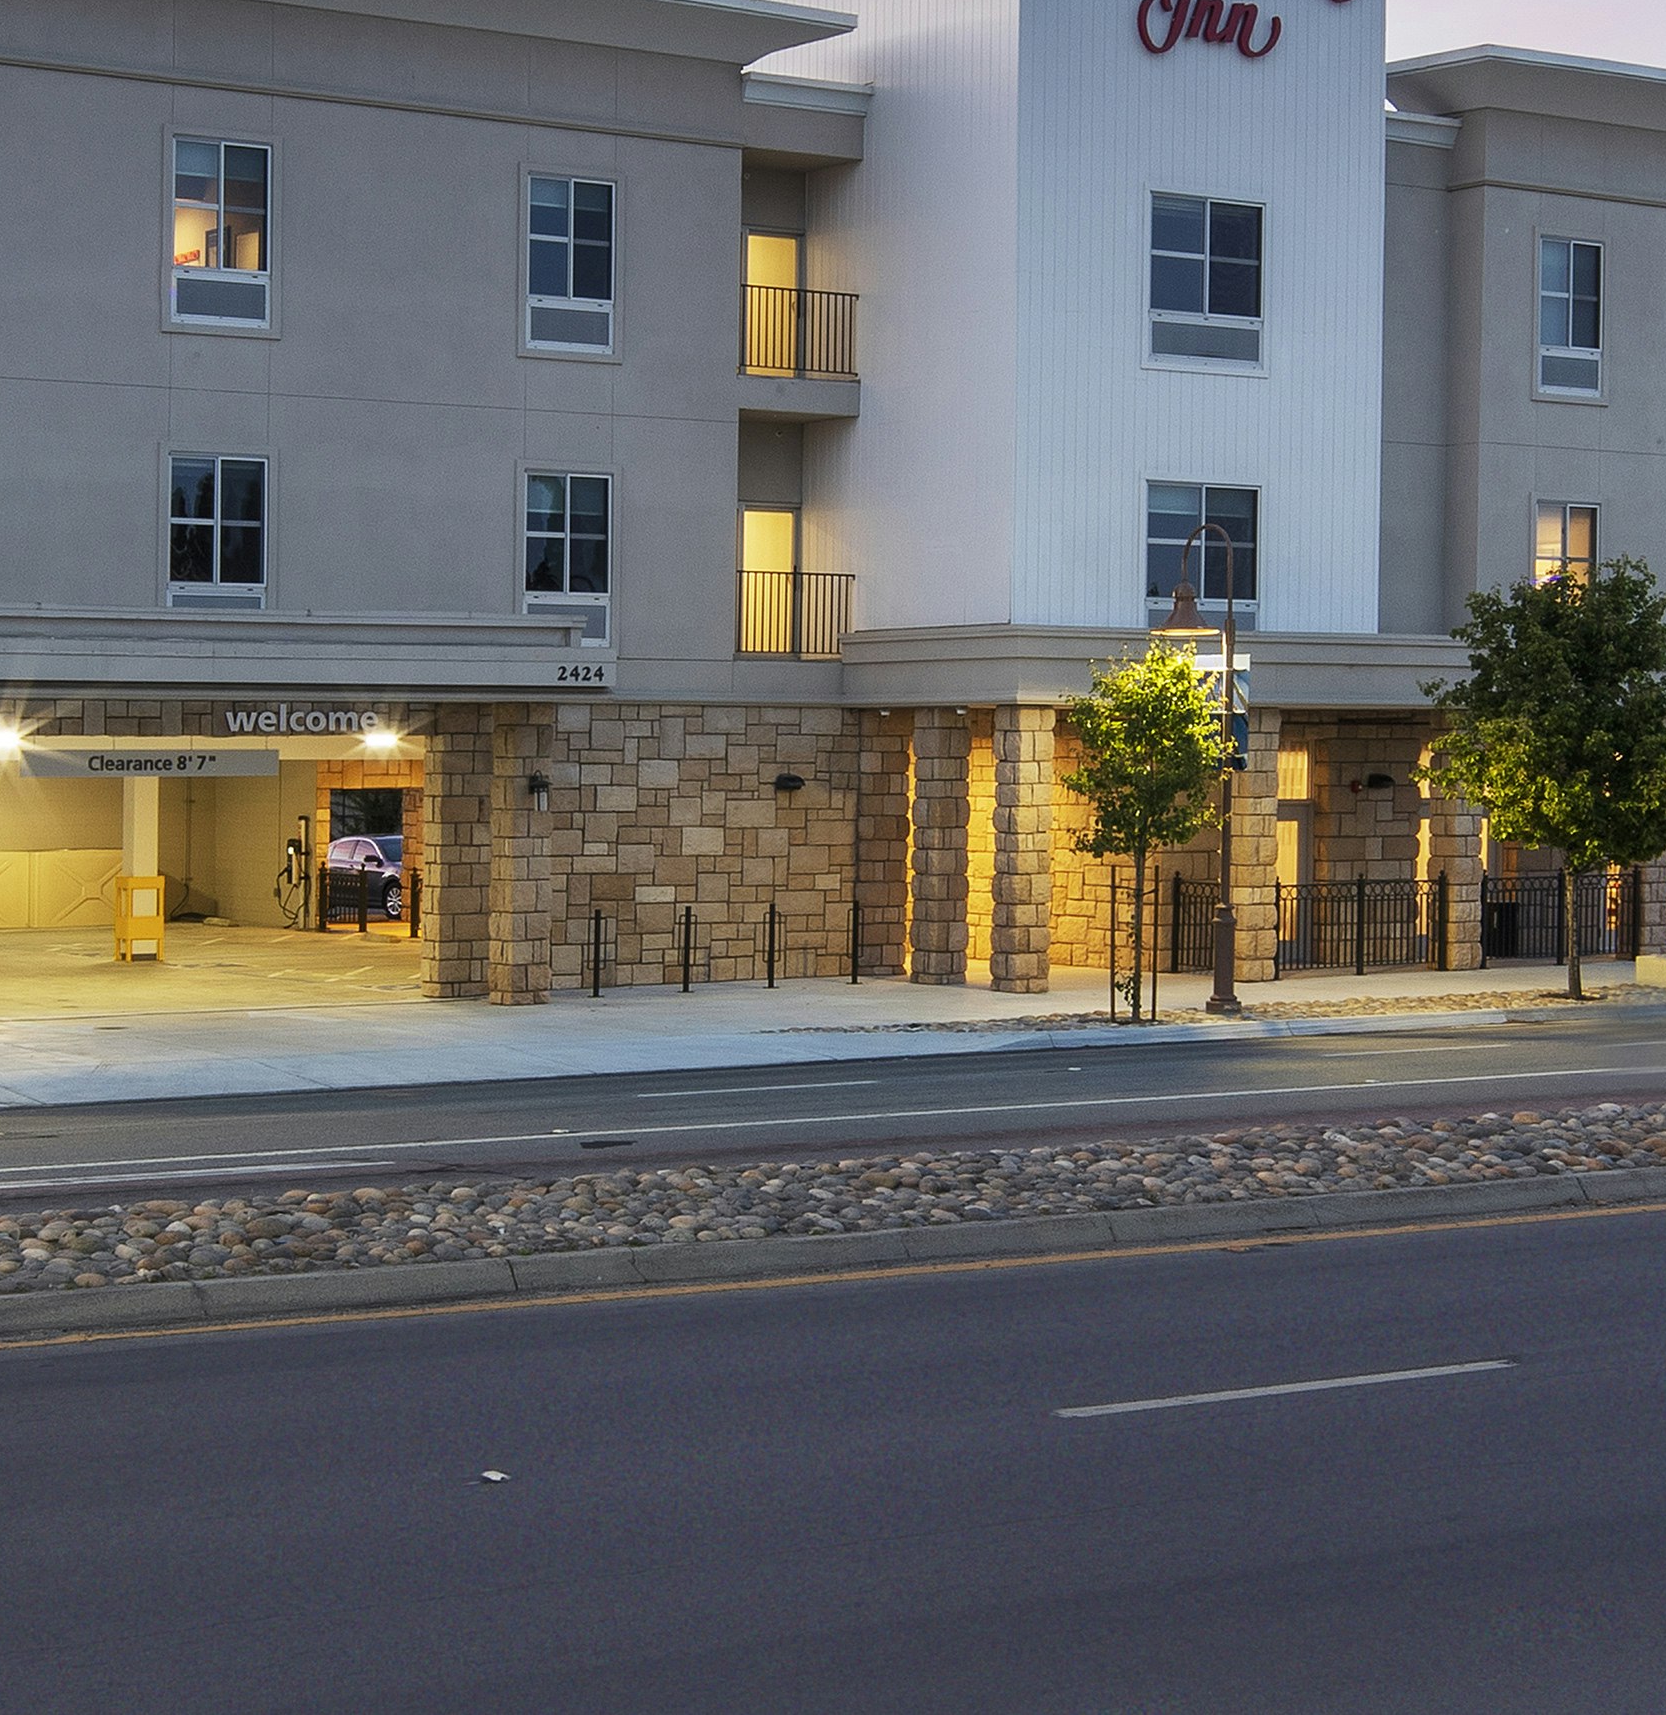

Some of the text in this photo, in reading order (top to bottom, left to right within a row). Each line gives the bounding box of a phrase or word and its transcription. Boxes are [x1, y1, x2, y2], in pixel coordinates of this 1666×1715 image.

[556, 664, 605, 682] 2424
[225, 704, 379, 733] welcome
[87, 755, 173, 771] Clearance
